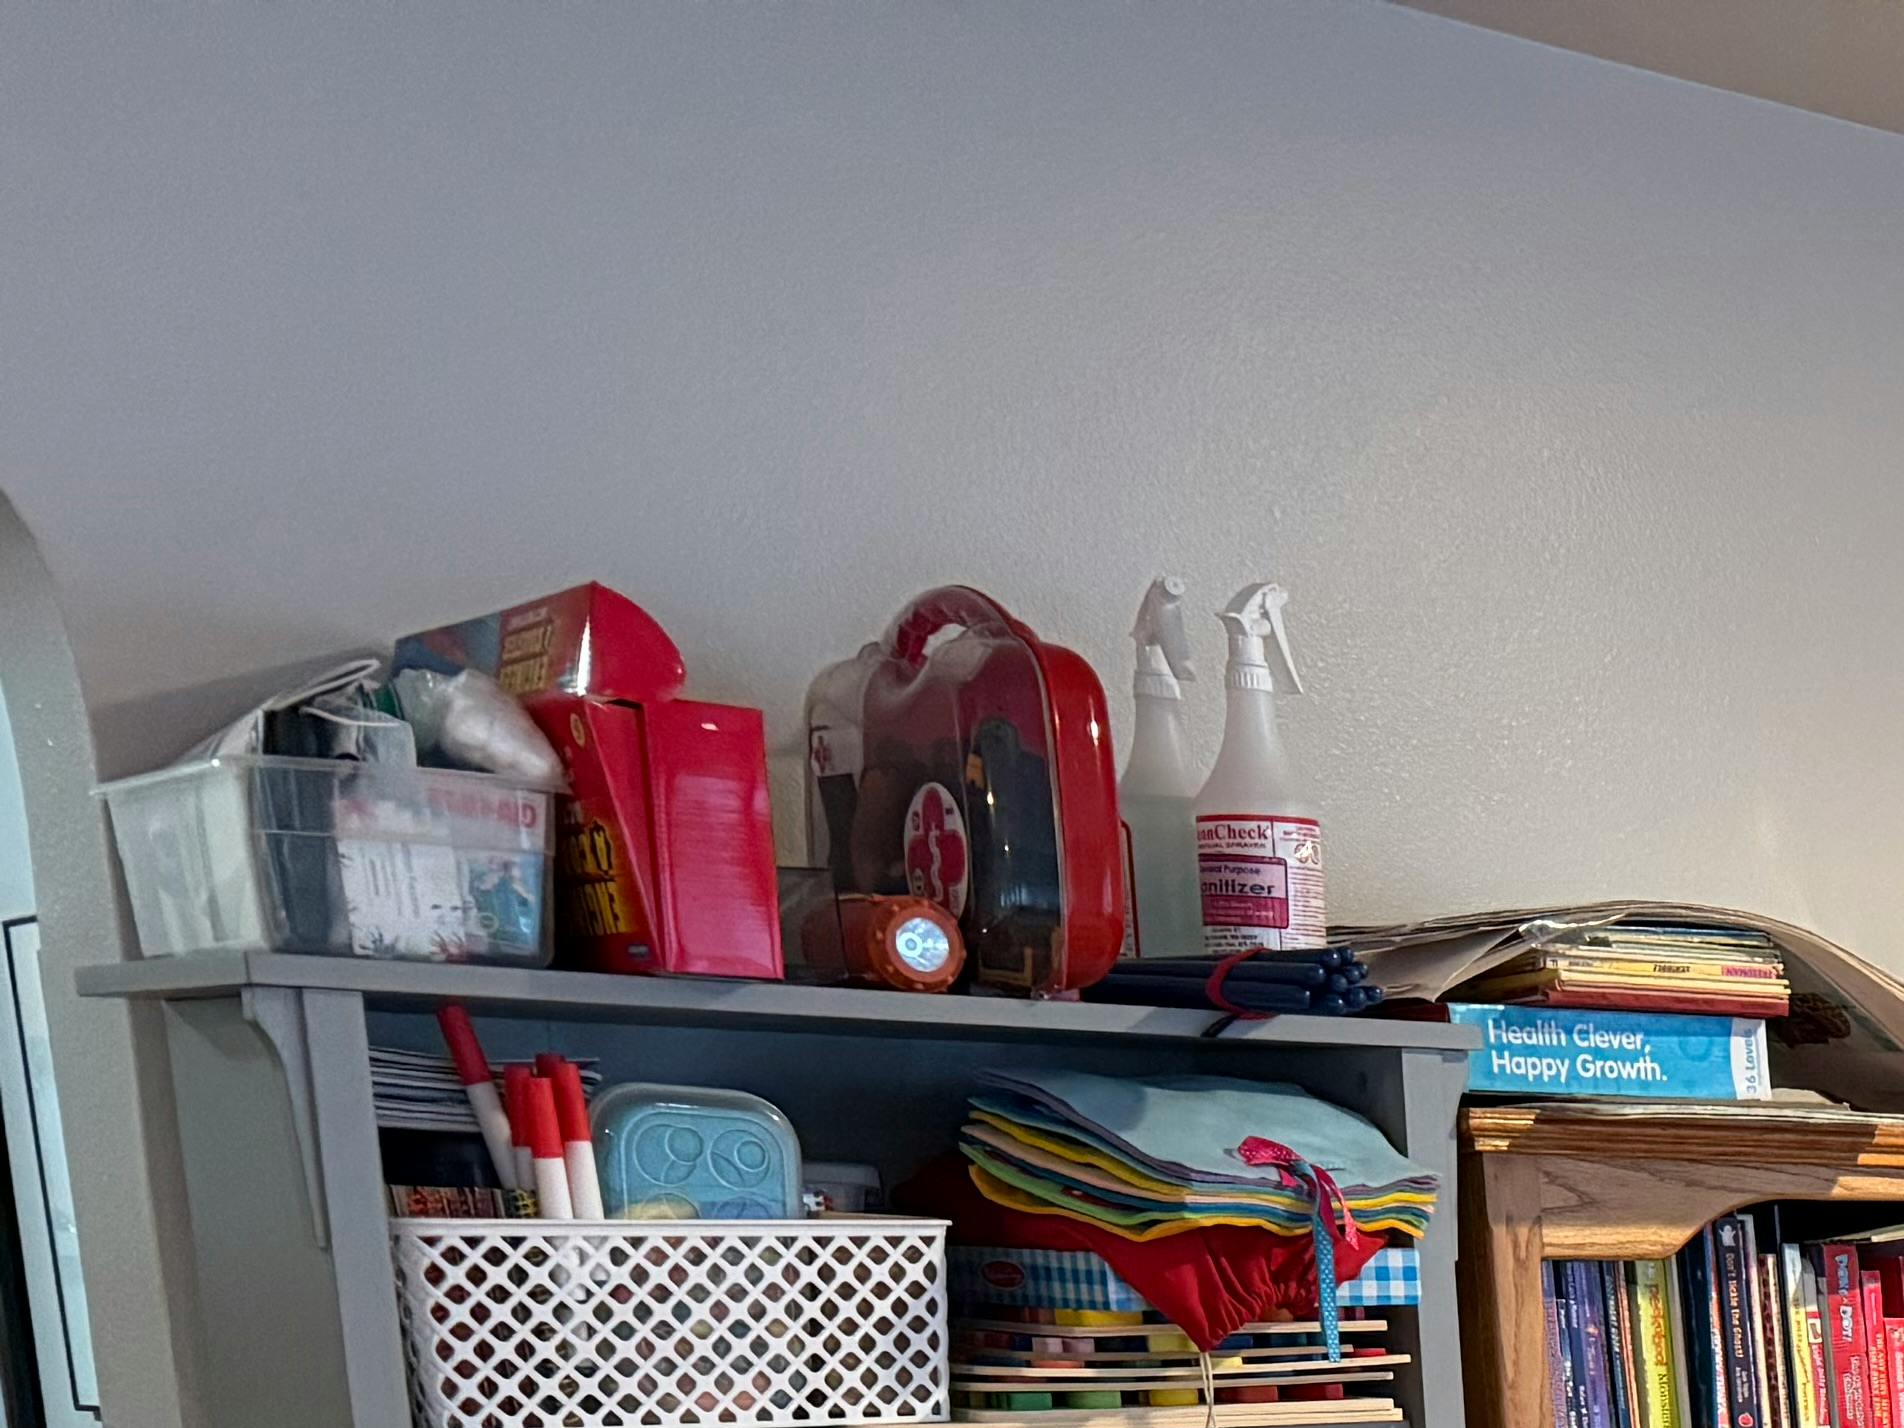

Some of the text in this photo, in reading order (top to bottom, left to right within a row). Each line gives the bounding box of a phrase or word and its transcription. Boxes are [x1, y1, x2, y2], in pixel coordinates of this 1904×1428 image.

[1488, 1019, 1650, 1054] Health Clever,
[1492, 1050, 1668, 1083] Happy Growth.
